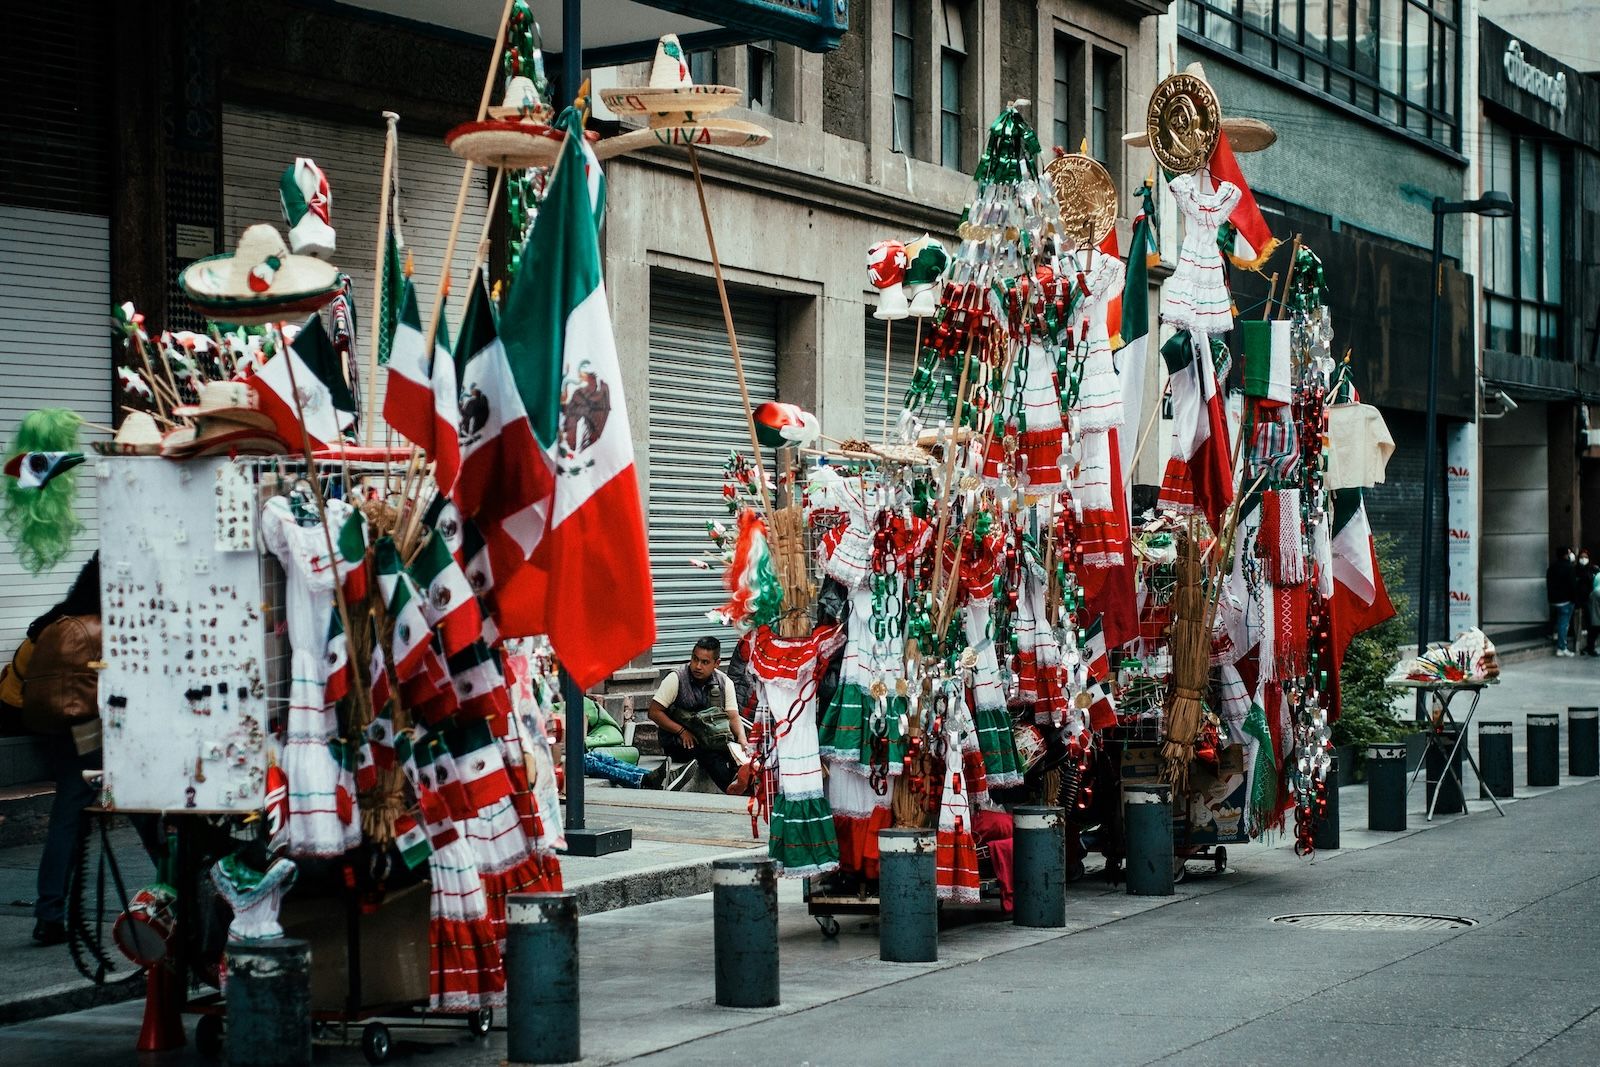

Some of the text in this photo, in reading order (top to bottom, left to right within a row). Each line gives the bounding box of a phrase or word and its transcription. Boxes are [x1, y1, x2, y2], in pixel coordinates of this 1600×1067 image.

[1149, 96, 1167, 137] VIVA
[1165, 78, 1212, 106] MEXICO
[654, 127, 711, 145] VIVA
